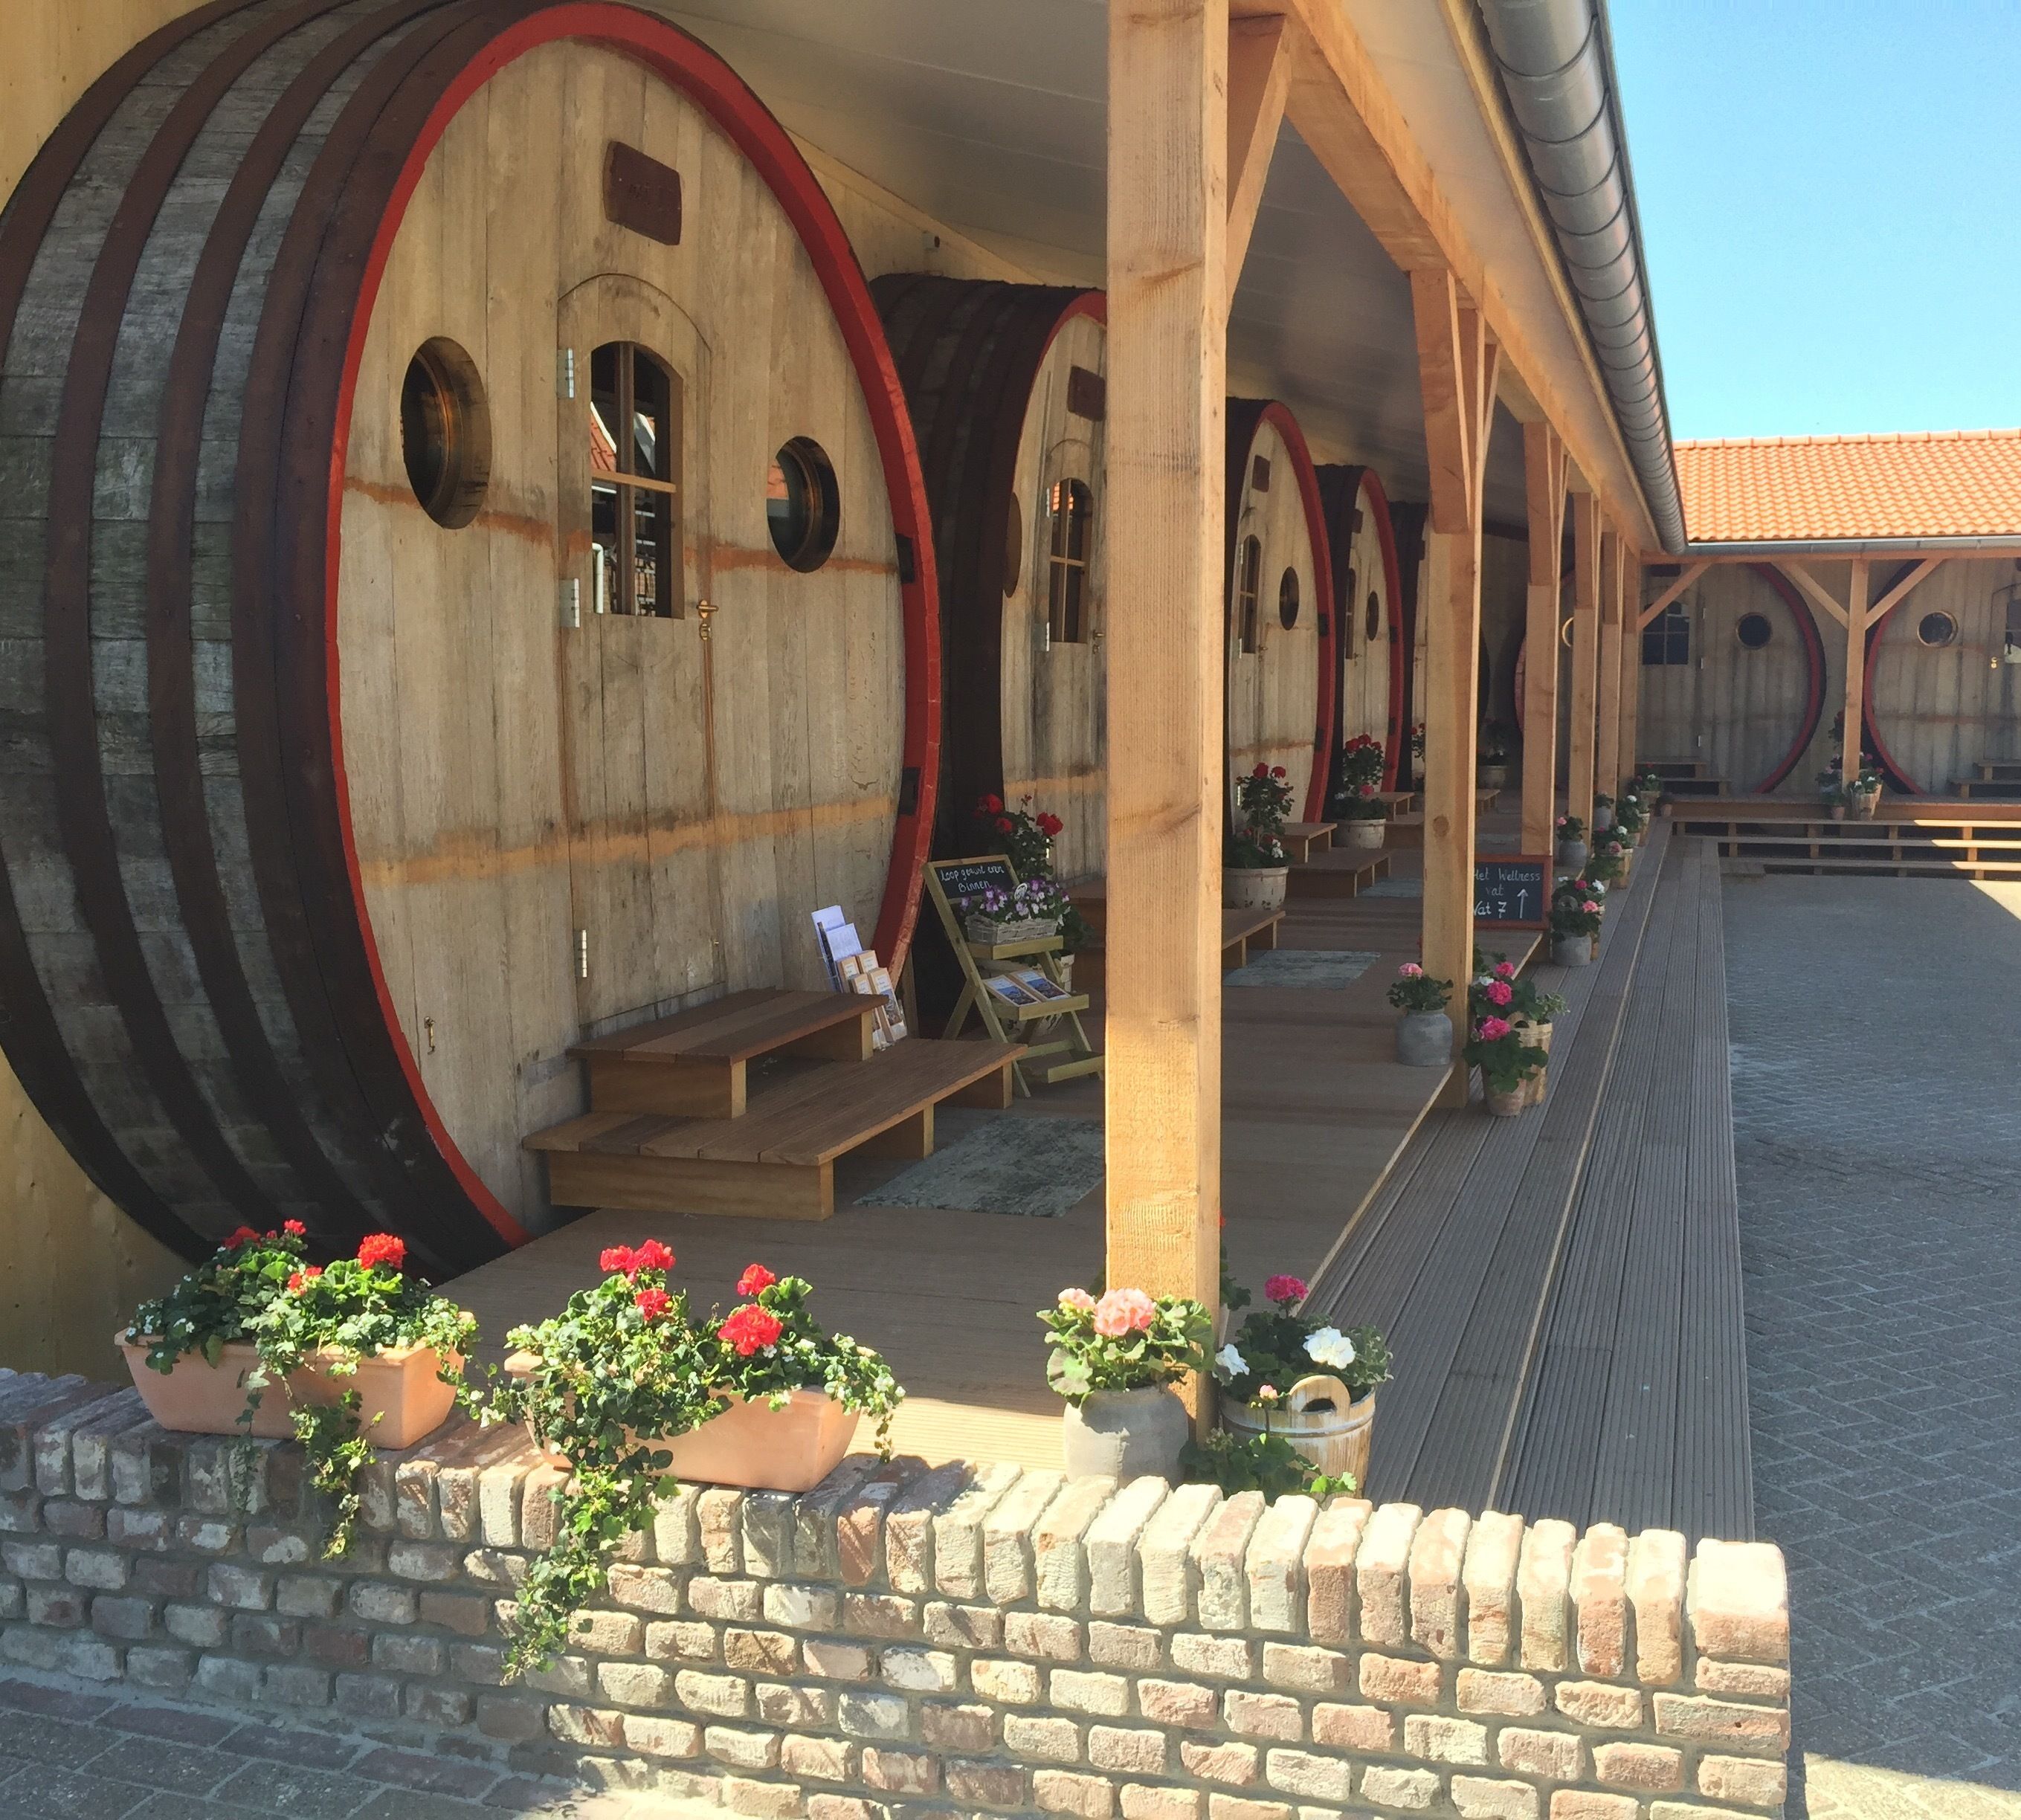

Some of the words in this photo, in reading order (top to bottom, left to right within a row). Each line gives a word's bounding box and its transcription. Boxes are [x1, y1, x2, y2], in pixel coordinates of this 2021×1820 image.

[1498, 868, 1541, 881] Wellness
[1486, 883, 1504, 896] vat
[1498, 901, 1507, 919] 7
